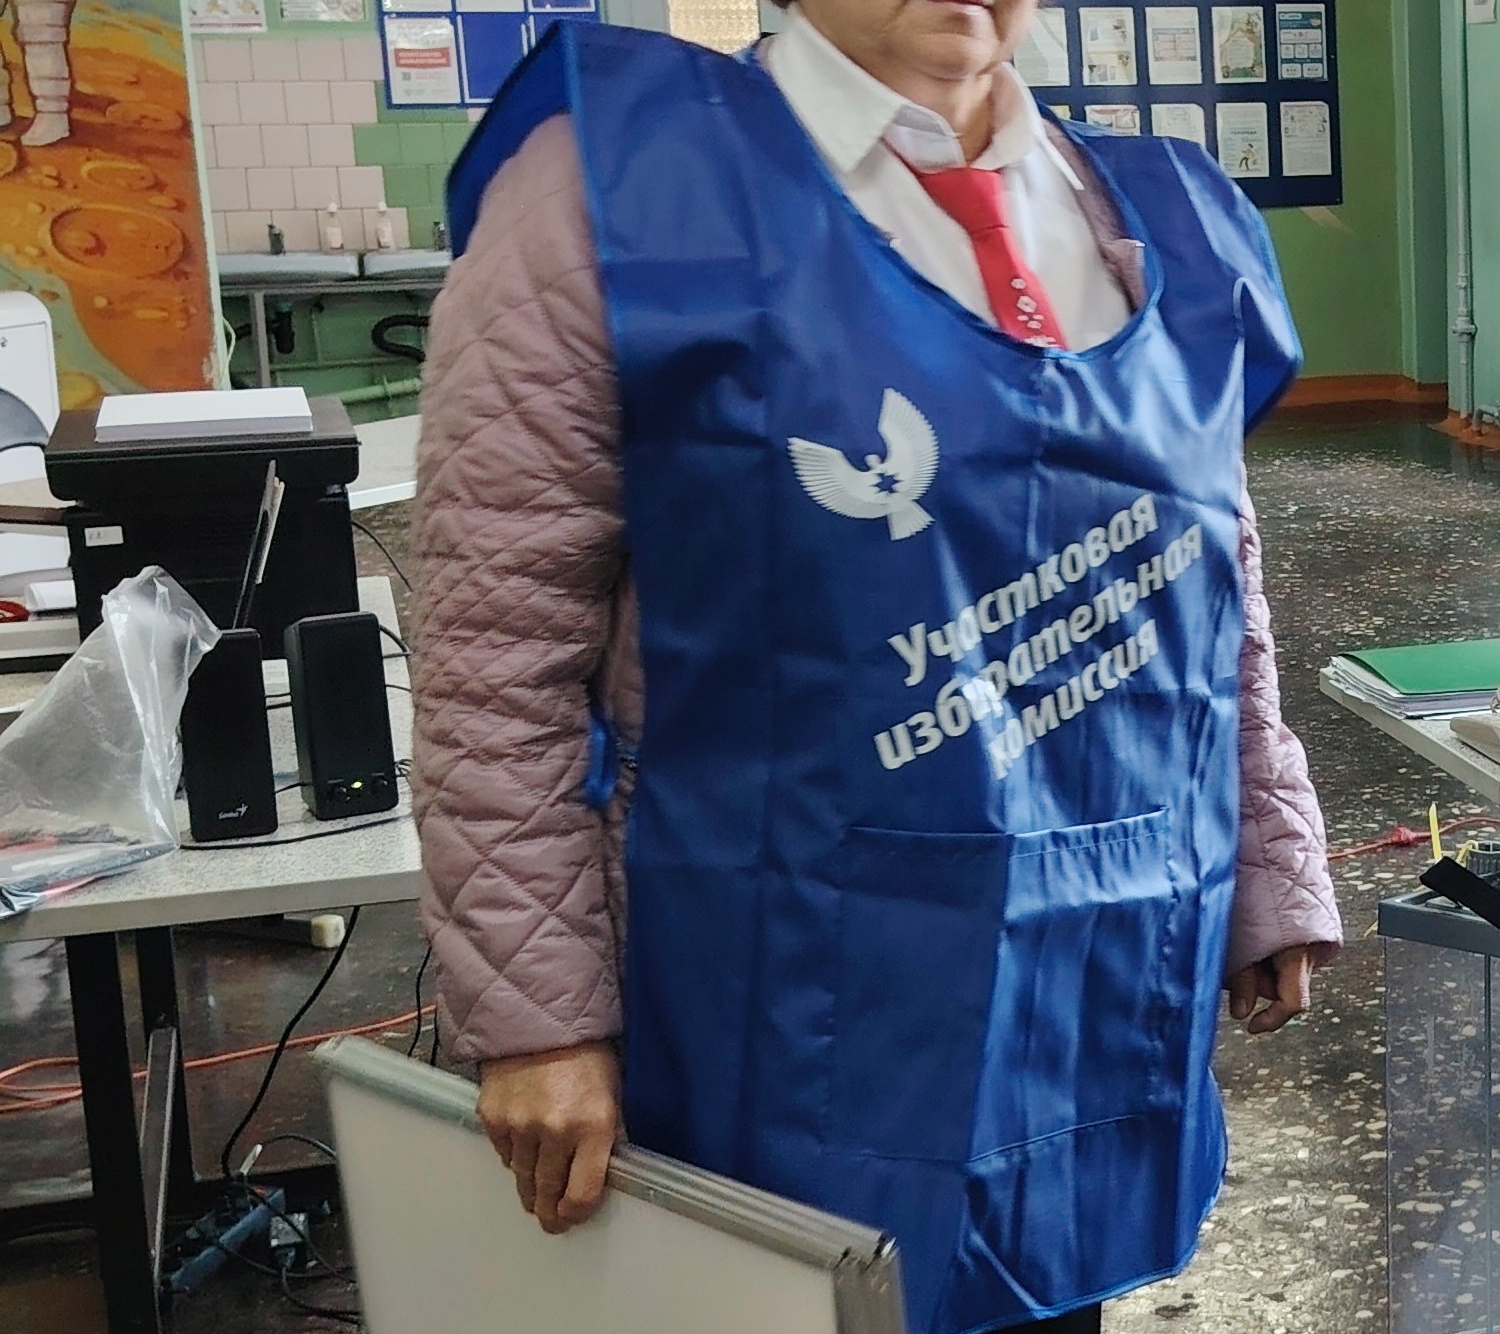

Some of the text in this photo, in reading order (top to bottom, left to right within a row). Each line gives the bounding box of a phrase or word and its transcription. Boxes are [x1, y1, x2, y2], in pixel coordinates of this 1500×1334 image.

[872, 523, 1202, 770] избирательная
[887, 492, 1159, 687] Участковая
[987, 618, 1160, 780] комиссия
